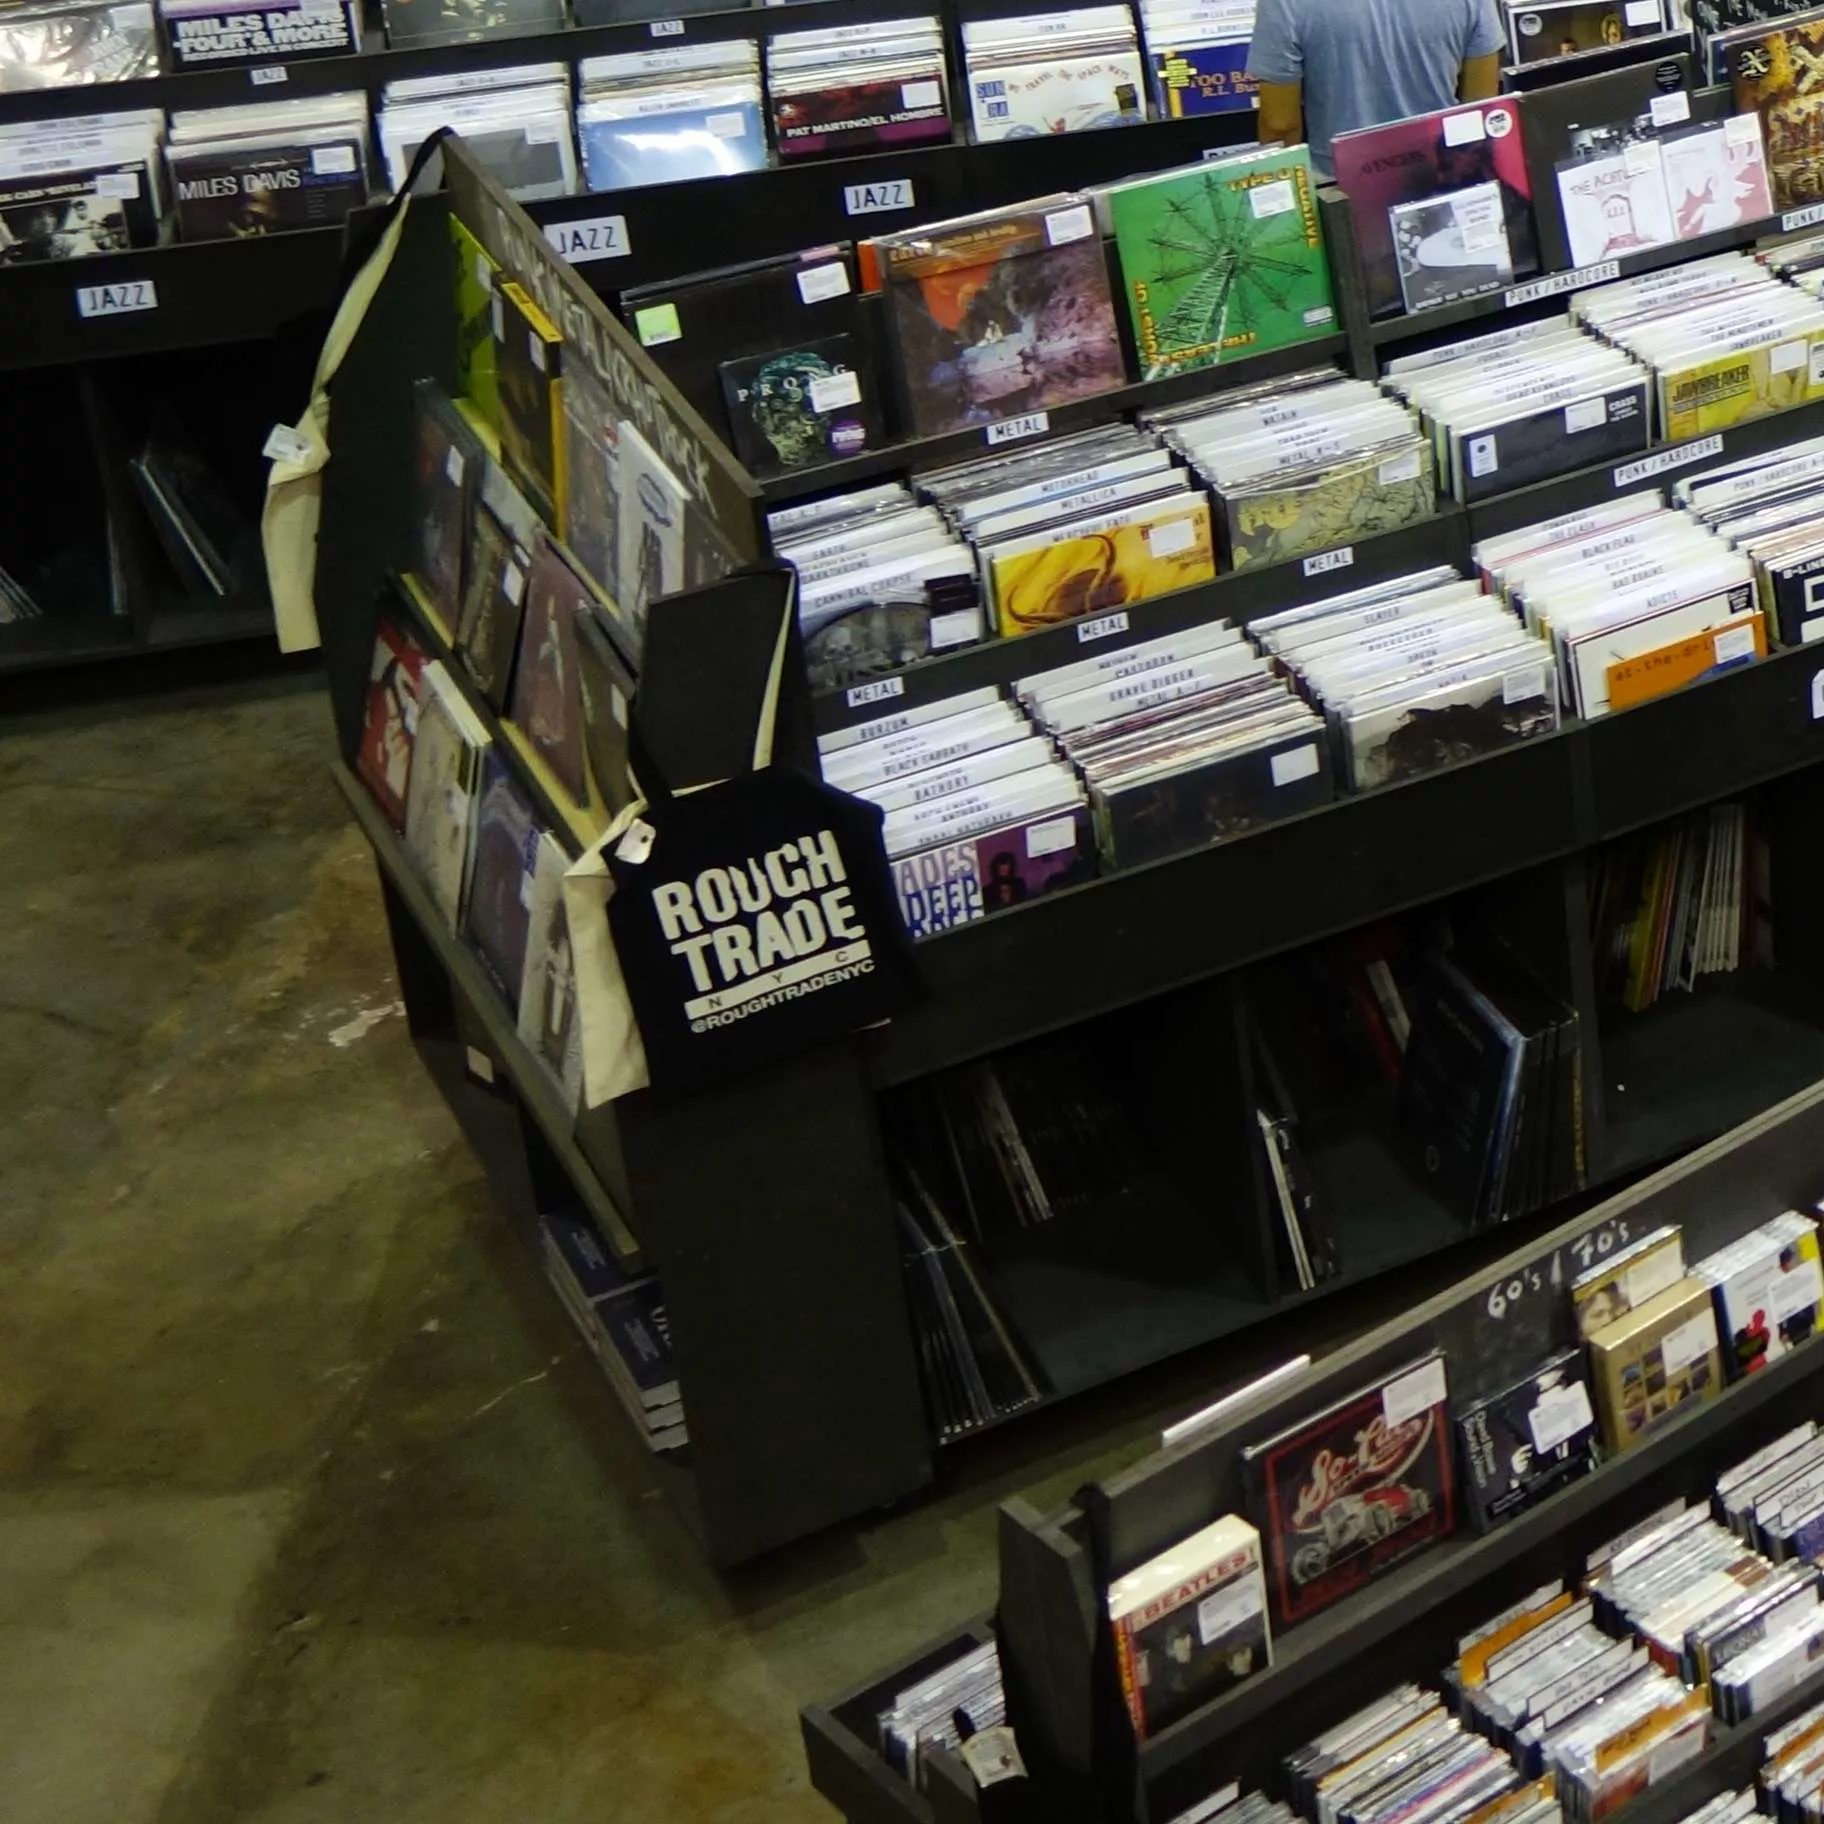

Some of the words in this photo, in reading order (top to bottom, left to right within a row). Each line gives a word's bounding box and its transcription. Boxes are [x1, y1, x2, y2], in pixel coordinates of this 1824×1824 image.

[178, 14, 263, 37] MILES
[273, 23, 347, 43] MORE
[976, 80, 1006, 96] SUN
[988, 101, 1009, 117] RA
[786, 125, 812, 138] PAT
[890, 106, 944, 125] HOMBRE
[178, 177, 239, 200] MILES
[243, 168, 300, 193] DAVIS
[852, 182, 906, 211] JAZZ
[1784, 211, 1817, 229] PUNK
[555, 222, 619, 254] JAZZ
[1506, 283, 1542, 306] PUNK
[1553, 262, 1620, 296] HARDCORE
[85, 286, 151, 312] JAZZ
[1671, 365, 1750, 400] JAWBREAKER
[1608, 394, 1638, 413] CRASS
[993, 419, 1041, 439] METAL
[1617, 466, 1649, 483] PUNK
[1657, 437, 1721, 470] HARDCORE
[1308, 549, 1353, 574] METAL
[1082, 617, 1125, 638] METAL
[852, 681, 899, 702] METAL
[651, 828, 848, 941] ROUGH
[670, 886, 869, 994] TRADE
[690, 957, 876, 1035] @ROUGHTRADENYC
[709, 995, 723, 1011] N
